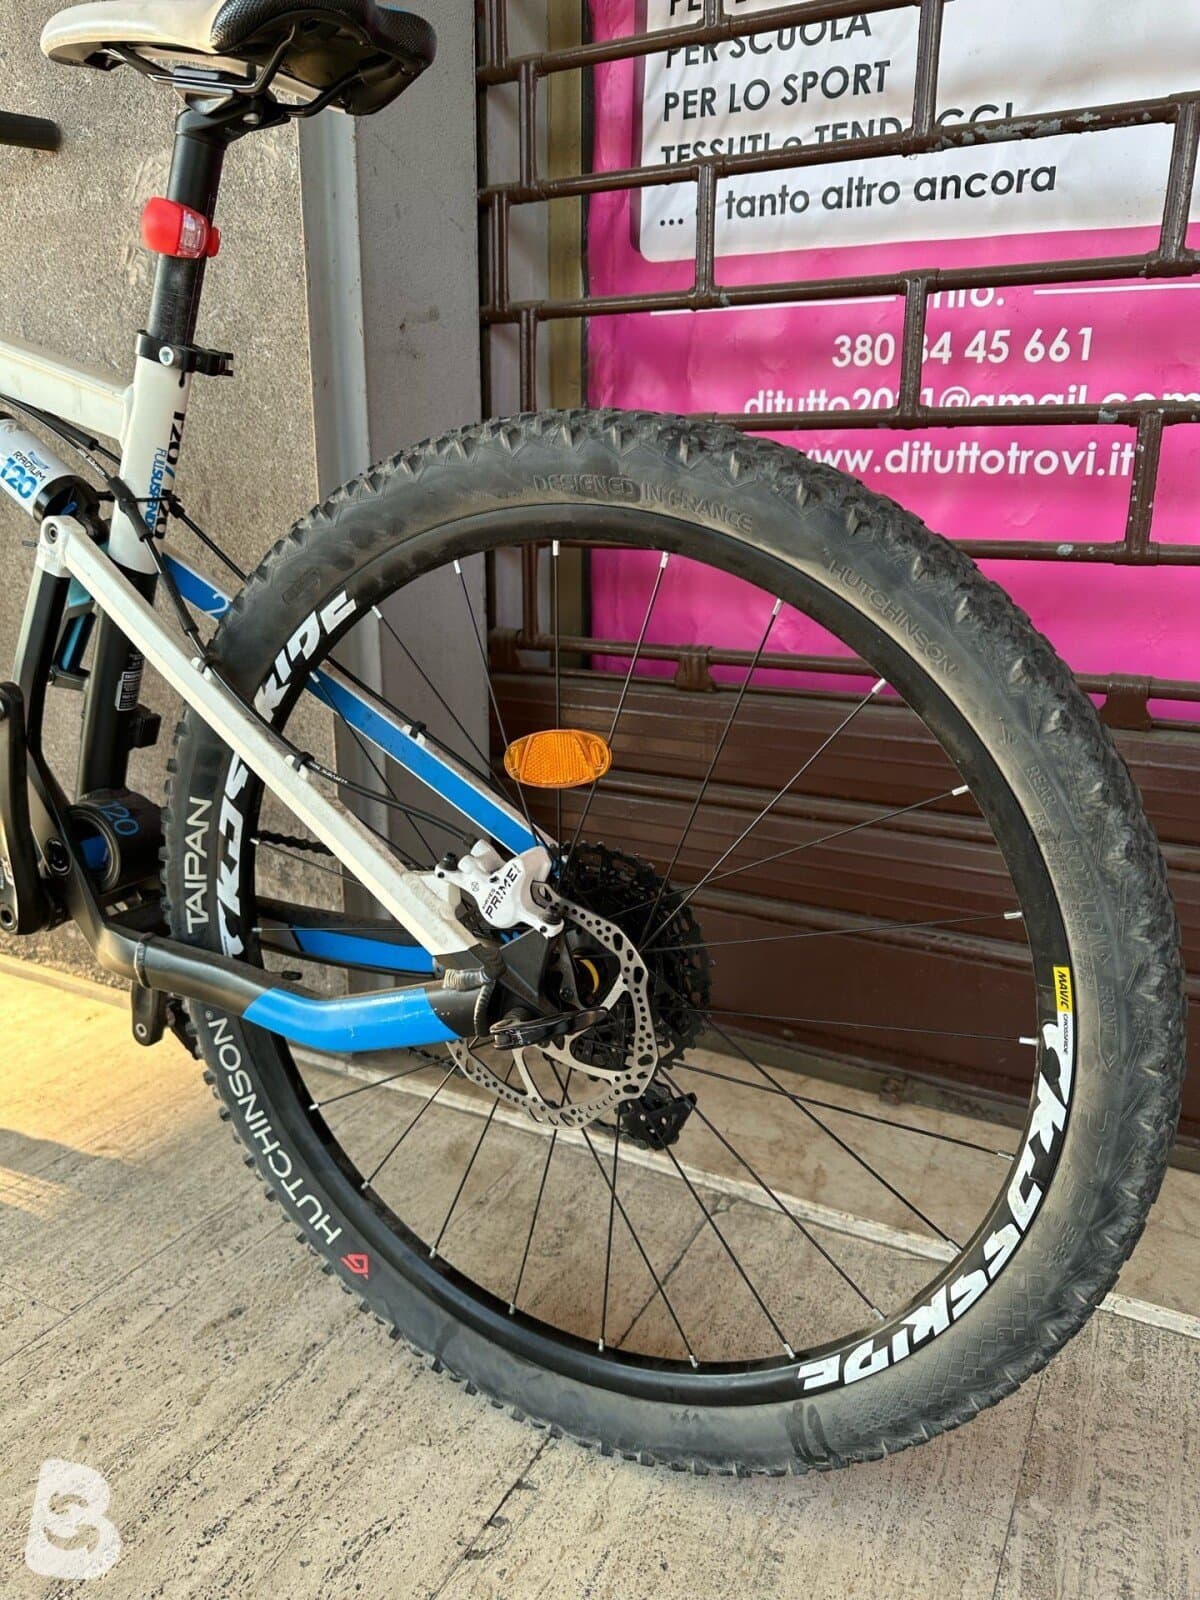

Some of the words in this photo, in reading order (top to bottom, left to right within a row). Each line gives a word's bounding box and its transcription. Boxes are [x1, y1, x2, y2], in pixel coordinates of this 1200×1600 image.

[664, 87, 717, 122] PER
[729, 79, 770, 113] LO
[780, 60, 891, 106] SPORT
[725, 184, 810, 220] tanto
[821, 176, 901, 210] altro
[914, 162, 1057, 201] ancora
[832, 333, 895, 368] 380
[964, 329, 1010, 363] 45
[1024, 327, 1093, 362] 661
[0, 457, 38, 499] 120
[801, 441, 1136, 476] ww.dituttotrovi.it
[826, 558, 959, 676] HUTCHINSON
[183, 796, 213, 934] TAIPAN
[1057, 971, 1071, 1010] MAVIC
[208, 1017, 342, 1245] HUTCHINSON
